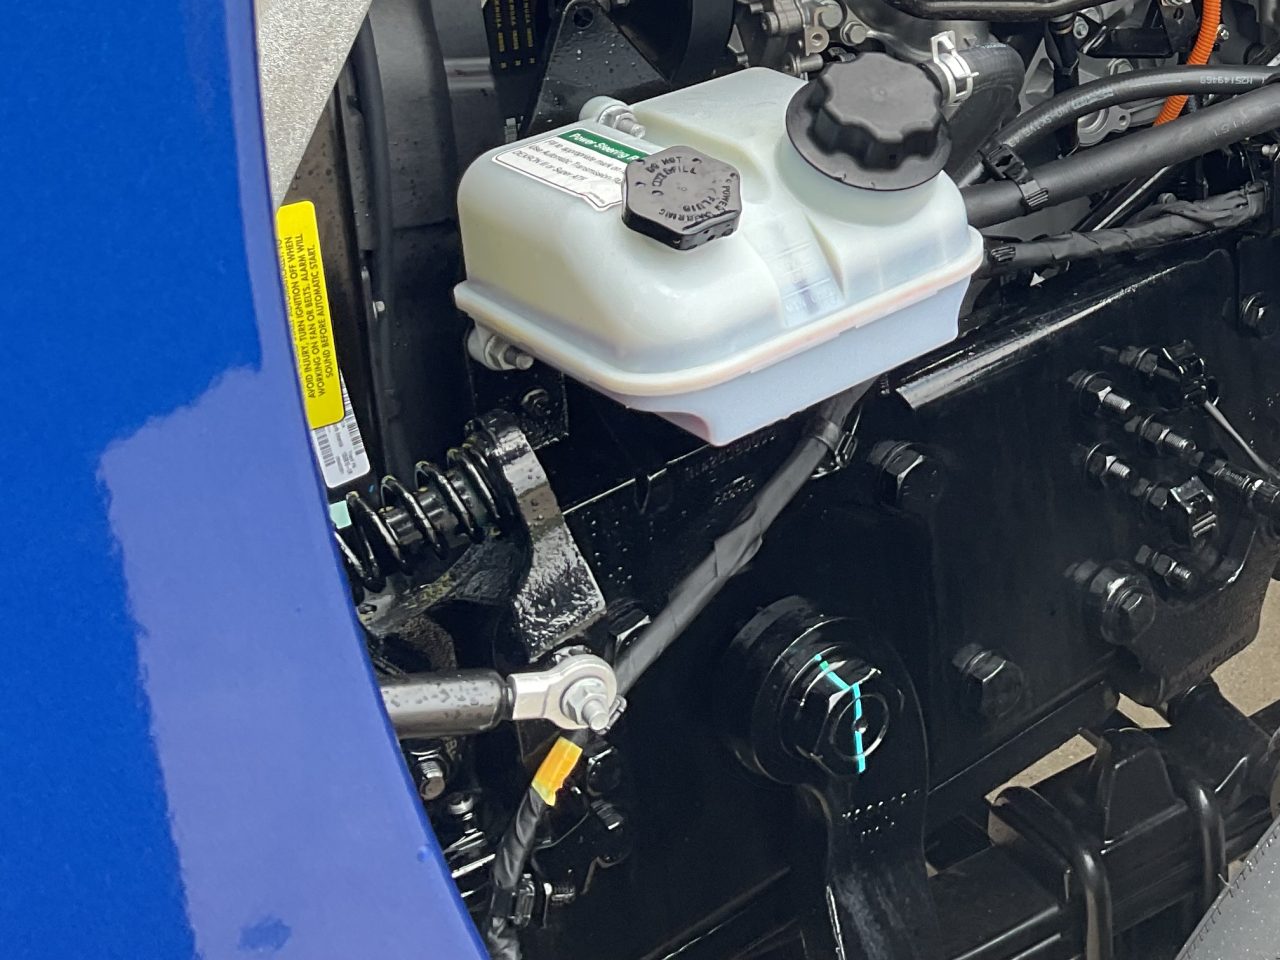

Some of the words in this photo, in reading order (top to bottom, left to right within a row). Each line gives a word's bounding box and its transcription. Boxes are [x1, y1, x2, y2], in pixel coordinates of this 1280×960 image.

[569, 132, 597, 145] Power
[594, 143, 630, 157] Steering
[683, 195, 715, 212] FLUID
[284, 236, 296, 262] WHEN
[295, 233, 306, 253] WILL
[288, 263, 299, 279] OFF
[298, 254, 310, 282] ALARM
[291, 280, 305, 318] IGNITION
[310, 271, 326, 317] AUTOMATIC
[306, 309, 315, 322] OR
[297, 319, 308, 341] TURN
[308, 323, 318, 340] FAN
[317, 318, 330, 348] BEFORE
[311, 341, 320, 355] ON
[313, 356, 327, 396] WORKING
[322, 349, 335, 378] SOUND
[305, 374, 316, 399] AVOID
